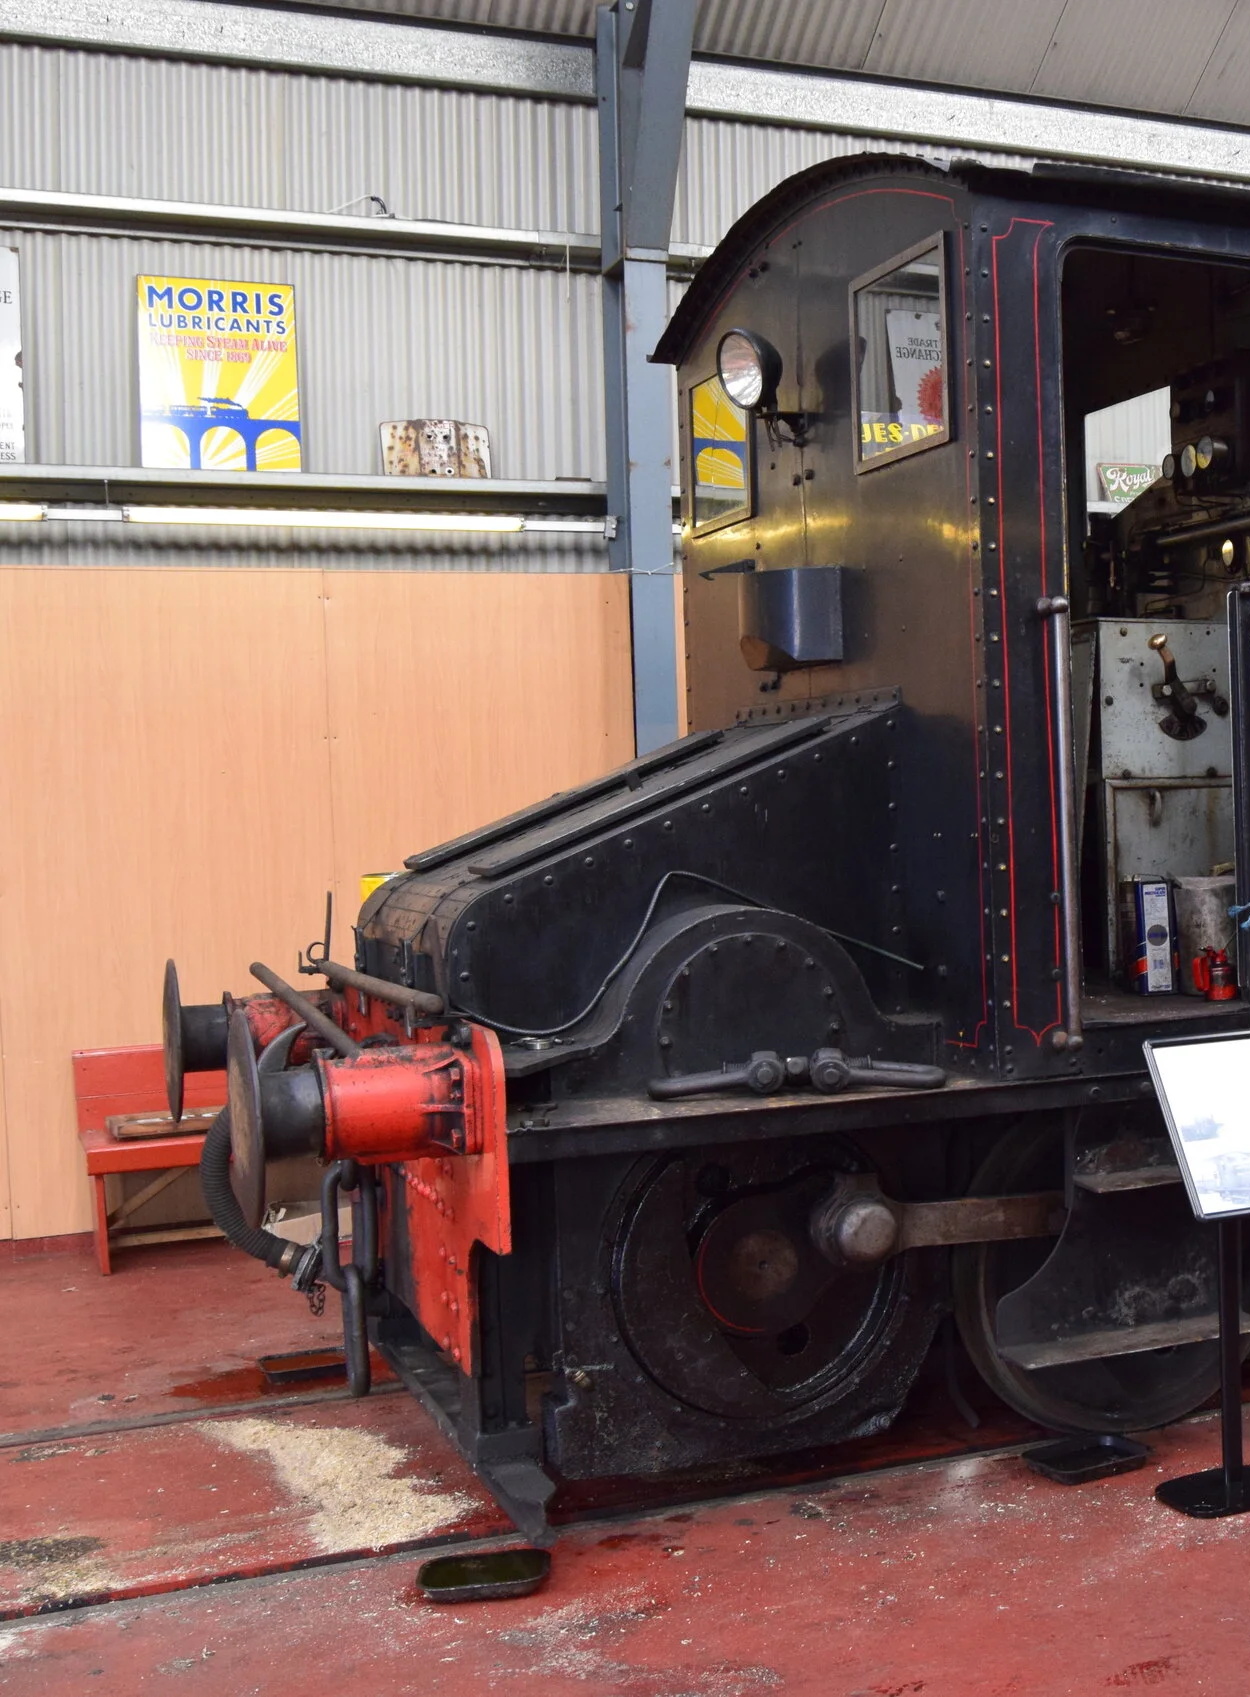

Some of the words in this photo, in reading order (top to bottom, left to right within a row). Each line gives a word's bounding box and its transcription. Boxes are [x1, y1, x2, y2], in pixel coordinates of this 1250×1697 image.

[146, 285, 285, 317] MORRIS
[148, 312, 287, 335] LUBRICANTS
[206, 335, 250, 351] STEAM
[251, 337, 288, 353] ALIVE
[186, 350, 223, 362] SINCE
[1106, 467, 1153, 492] Royal
